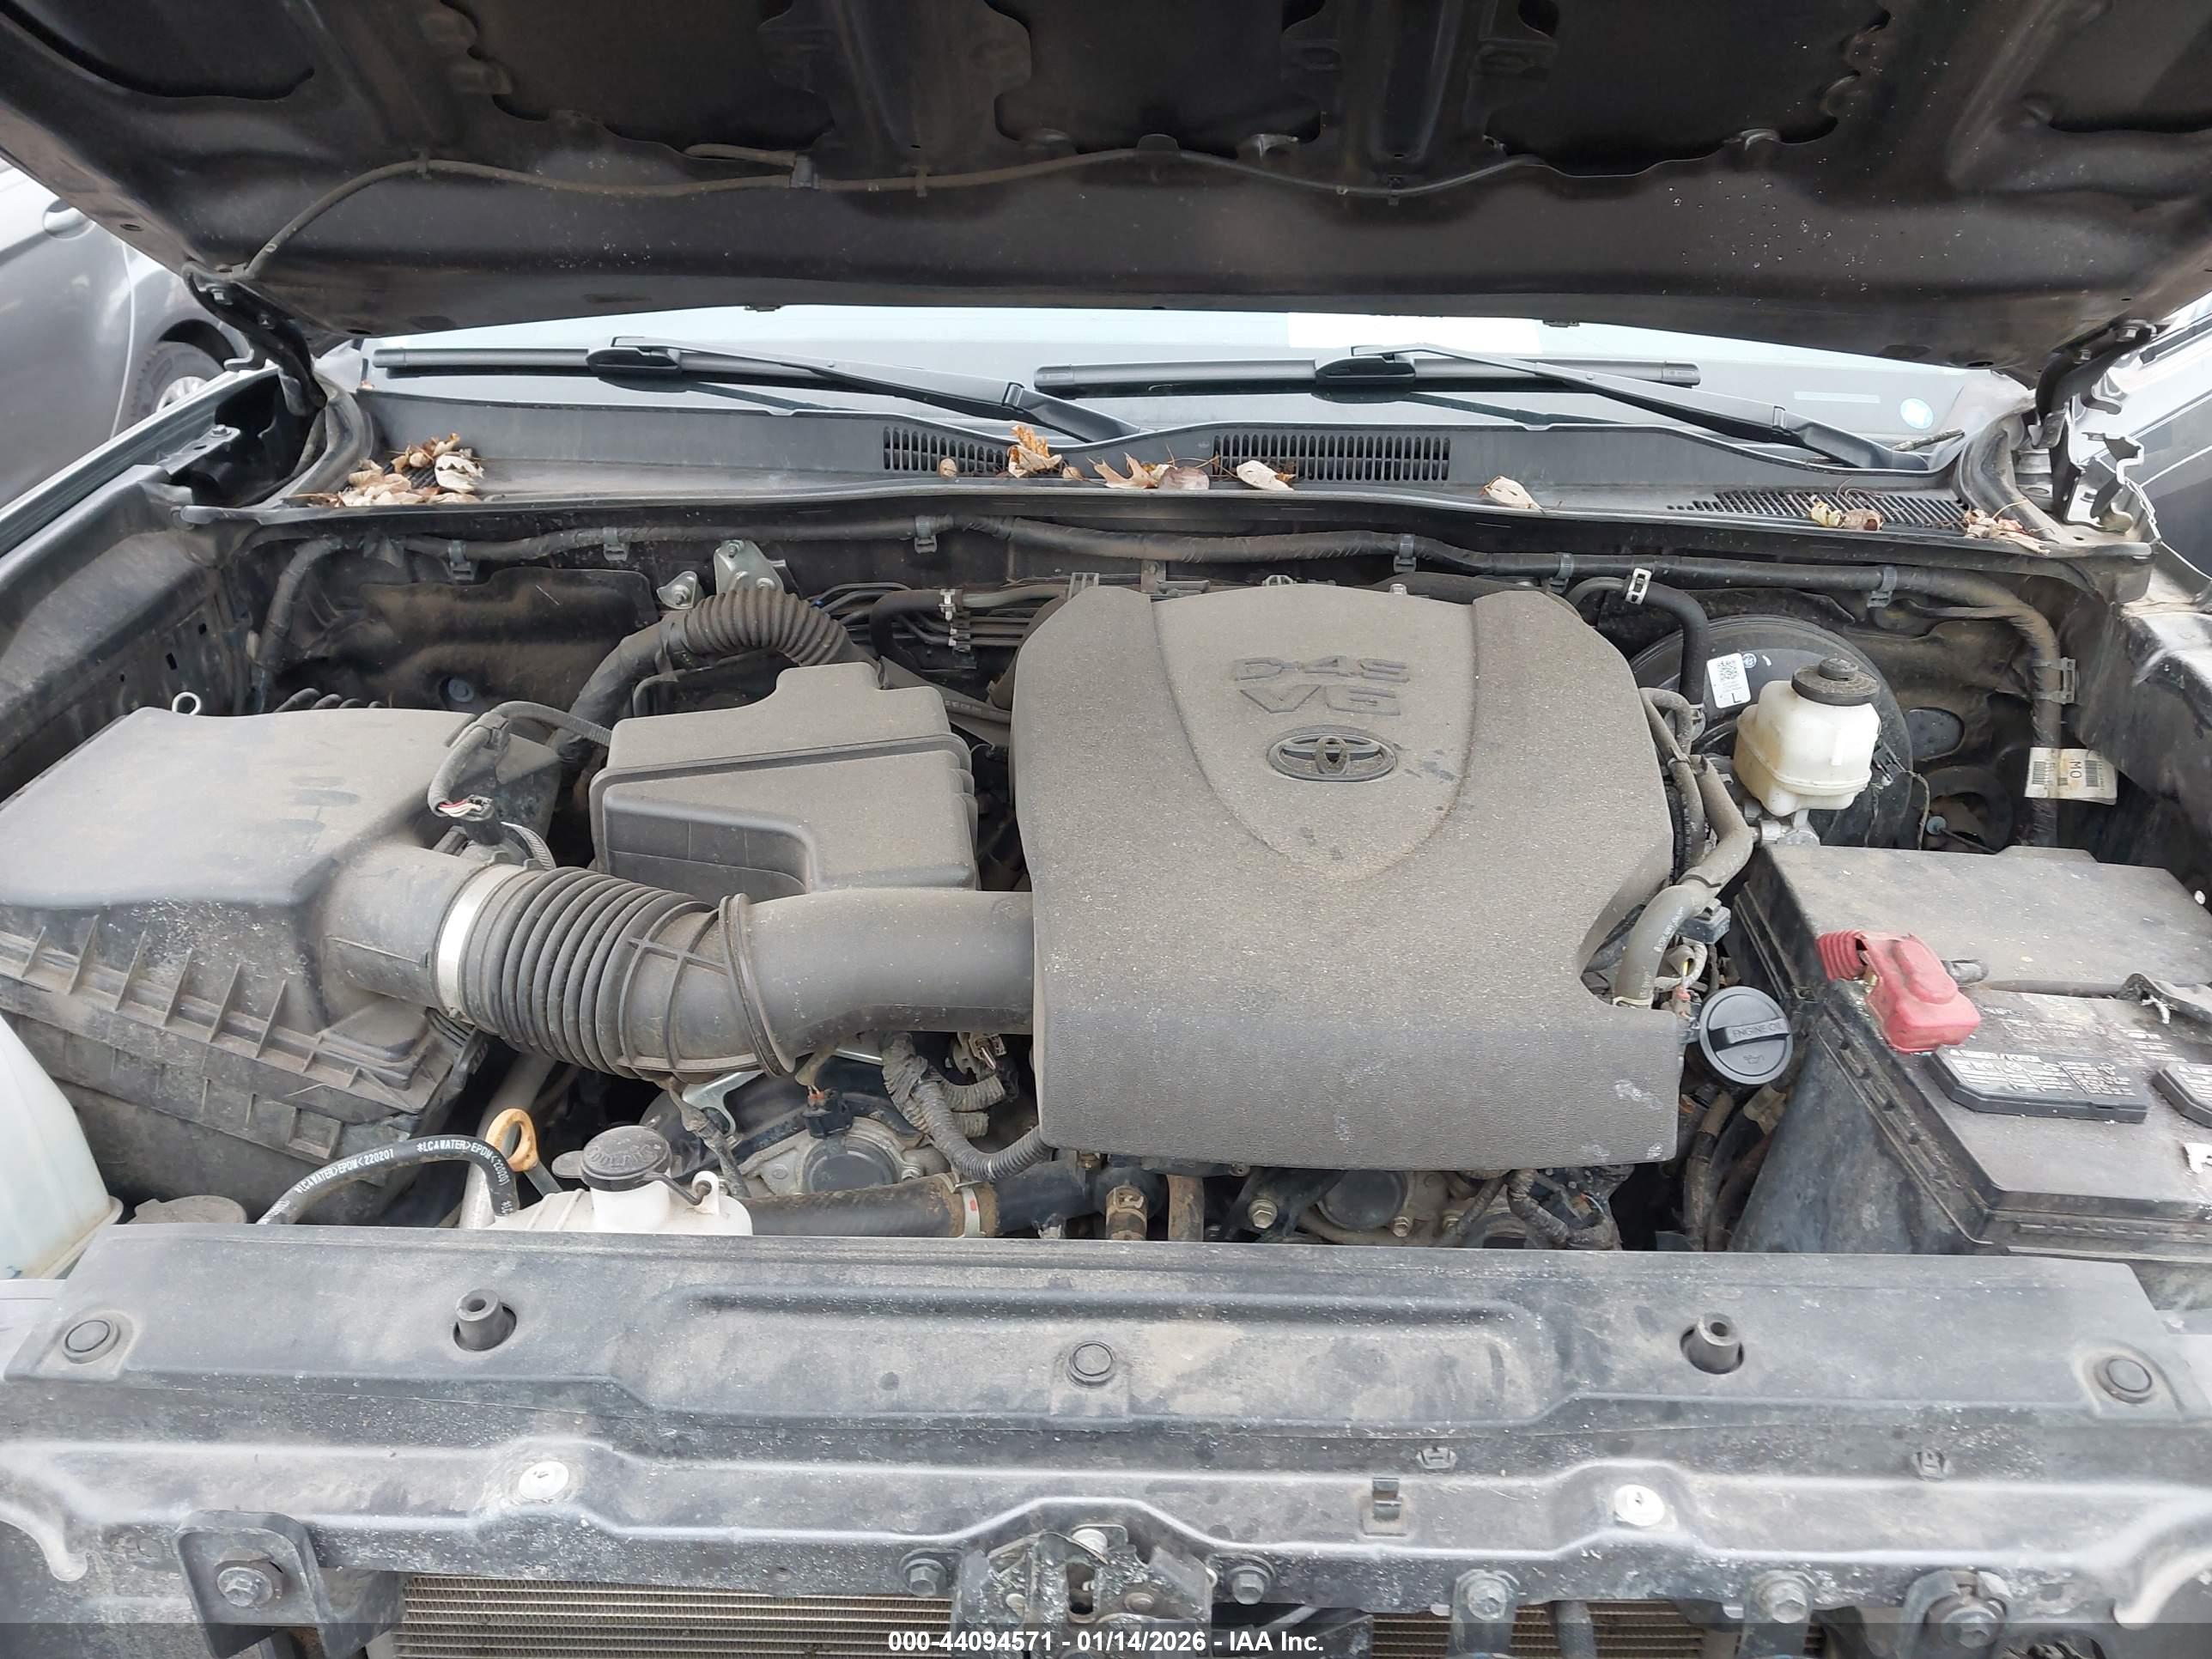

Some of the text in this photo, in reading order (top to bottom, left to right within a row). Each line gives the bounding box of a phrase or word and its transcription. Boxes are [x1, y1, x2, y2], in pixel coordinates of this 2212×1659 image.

[1233, 655, 1411, 684] D-4S
[1240, 684, 1401, 716] V6
[1731, 692, 1743, 704] L
